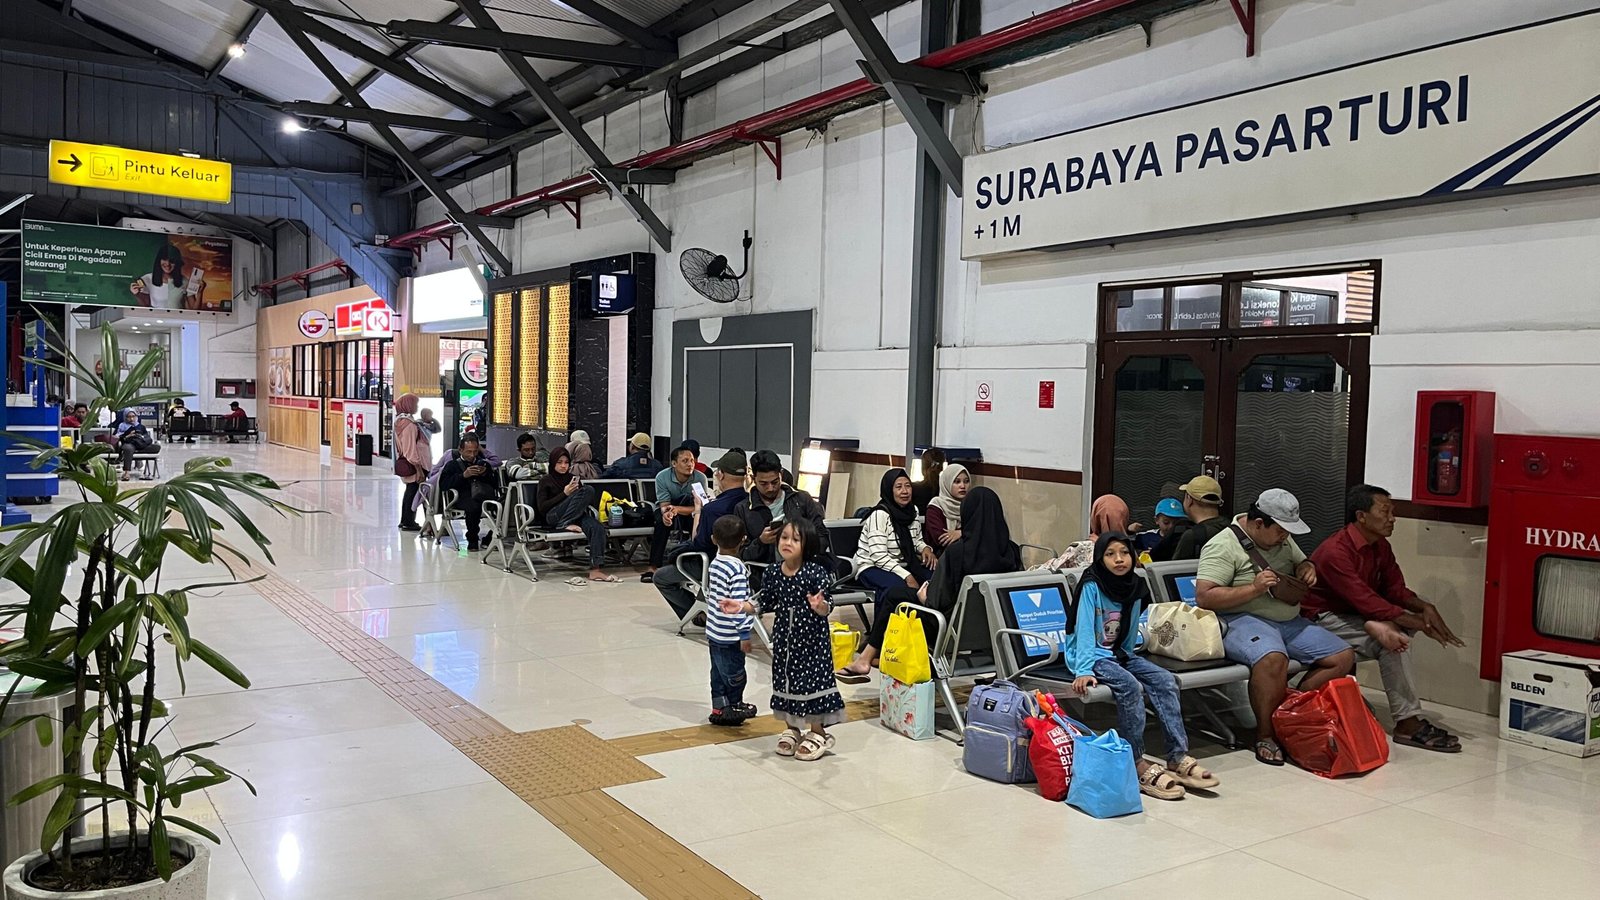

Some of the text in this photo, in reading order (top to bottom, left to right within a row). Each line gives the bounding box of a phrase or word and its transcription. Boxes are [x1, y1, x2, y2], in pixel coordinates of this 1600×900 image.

[975, 75, 1469, 210] SURABAYA PASARTURI
[124, 160, 220, 182] Pintu Keluar
[124, 173, 140, 181] Exit
[25, 242, 126, 257] Untuk Keperluan Apapun
[25, 260, 67, 270] Sekarang!
[44, 252, 67, 260] Emas
[78, 255, 122, 264] Pegadaian
[1525, 527, 1600, 552] HYDRA
[1511, 681, 1546, 696] BELDEN
[1060, 755, 1073, 766] BI
